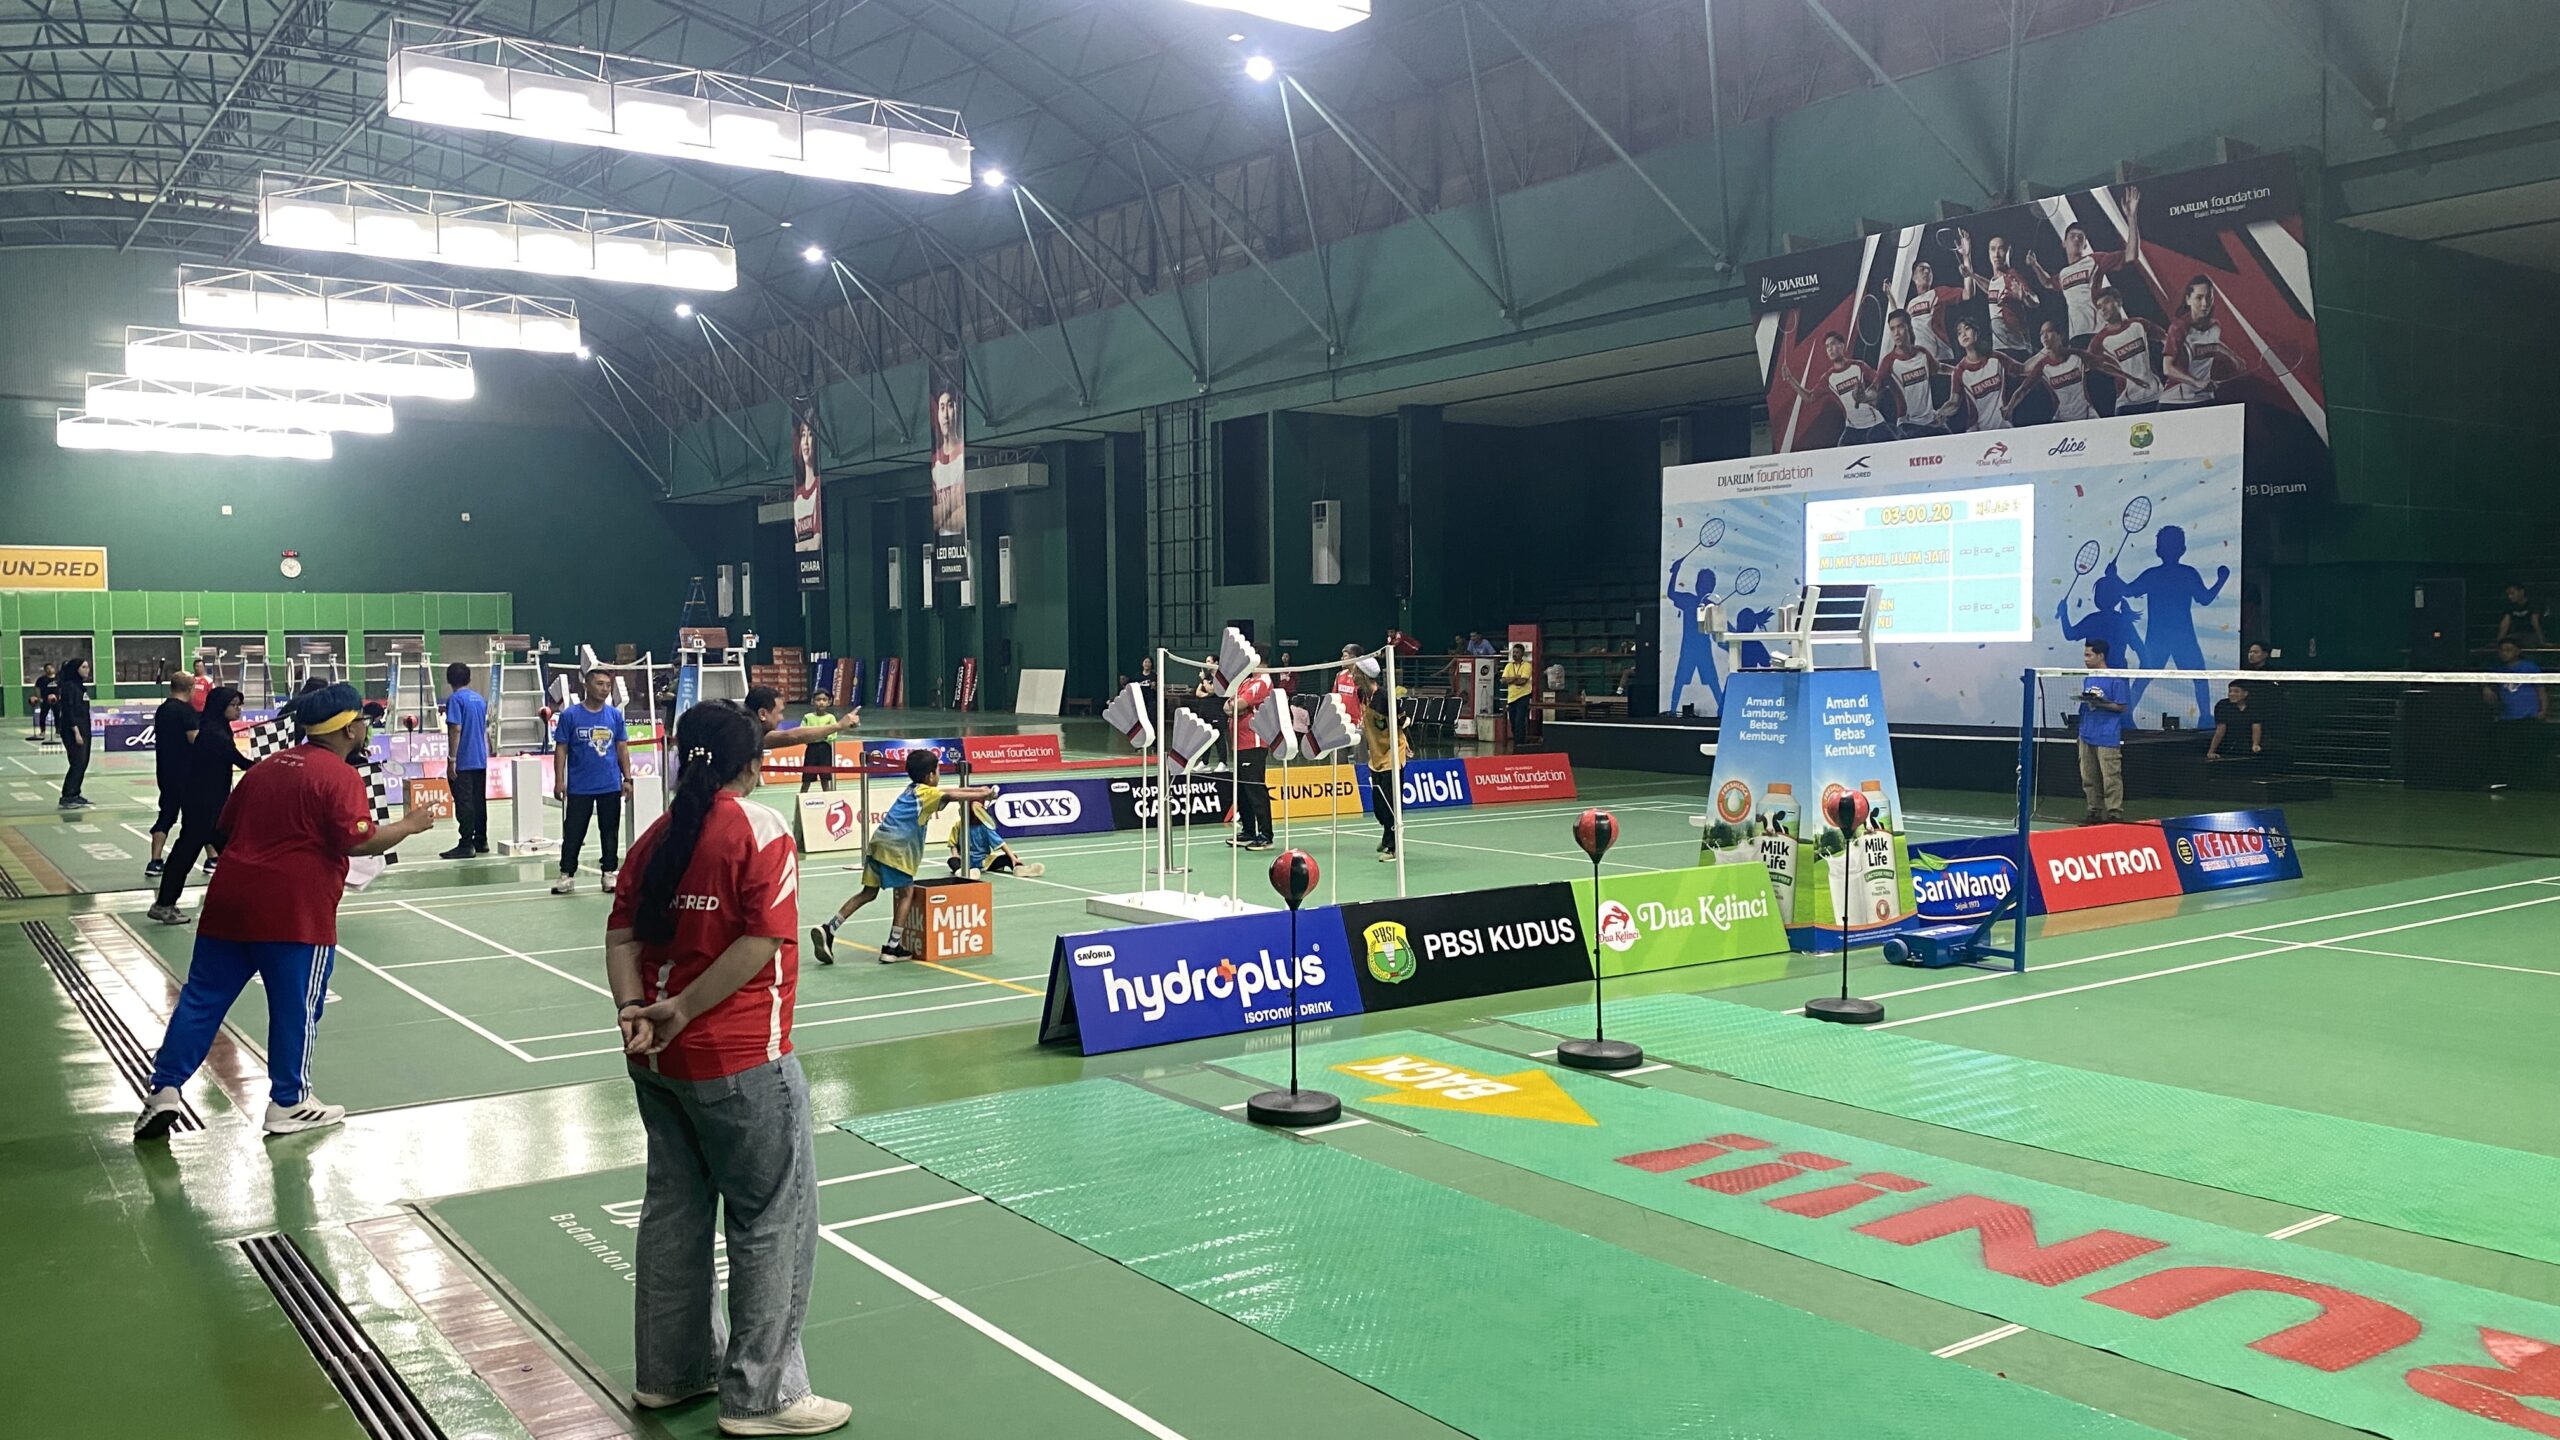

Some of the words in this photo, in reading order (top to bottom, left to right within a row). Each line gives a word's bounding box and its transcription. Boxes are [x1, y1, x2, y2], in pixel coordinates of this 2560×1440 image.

[2169, 200, 2209, 216] DJARUM
[2210, 187, 2271, 208] foundation
[1778, 273, 1819, 291] DJARUM
[2048, 437, 2086, 456] Aice
[1909, 456, 1943, 467] KENKO
[1717, 473, 1754, 487] DJARUM
[1756, 465, 1813, 483] foundation
[2261, 483, 2306, 496] Djarum
[0, 561, 99, 577] UNDRED
[1745, 696, 1774, 707] Aman
[1775, 696, 1785, 707] di
[1826, 696, 1857, 709] Aman
[1858, 695, 1868, 708] di
[1741, 708, 1788, 721] Lambung,
[1822, 712, 1875, 727] Lambung,
[1750, 719, 1778, 730] Bebas
[1834, 727, 1865, 740] Bebas
[972, 749, 1005, 760] DJARUM
[1006, 745, 1054, 758] foundation
[1475, 773, 1512, 786] DJARUM
[1513, 768, 1566, 783] foundation
[414, 789, 449, 804] Milk
[1132, 786, 1159, 799] KOP
[1281, 781, 1353, 800] HUNDRED
[828, 801, 846, 832] 5
[1008, 796, 1072, 819] FOX'S
[1760, 839, 1790, 857] Milk
[1864, 837, 1889, 854] Milk
[2193, 827, 2264, 861] KENKO
[1763, 856, 1787, 870] Life
[1867, 852, 1888, 867] Life
[2048, 846, 2161, 885] POLYTRON
[1912, 866, 2011, 904] SariWangi
[932, 903, 987, 932] Milk
[1637, 901, 1695, 931] Dua
[1699, 890, 1768, 932] Kelinci
[937, 929, 984, 957] Life
[1372, 926, 1397, 944] PBSI
[1423, 928, 1485, 960] PBSI
[1487, 917, 1576, 952] KUDUS
[1615, 929, 1640, 943] Kelinci
[1077, 949, 1112, 961] SAVORIA
[1103, 949, 1326, 1022] hydroplus
[1300, 1000, 1333, 1016] DRINK
[550, 1212, 631, 1271] Badminton
